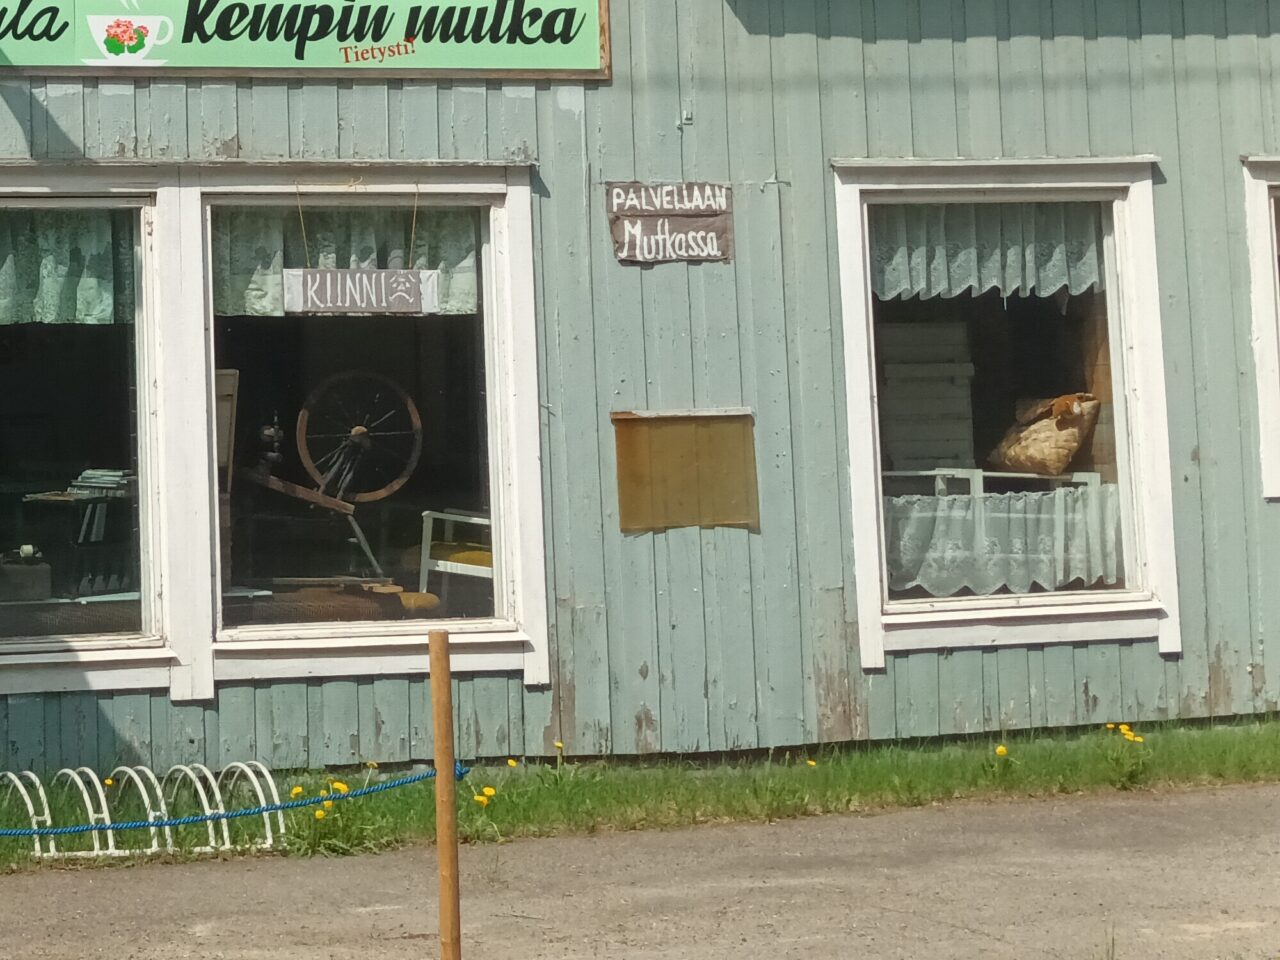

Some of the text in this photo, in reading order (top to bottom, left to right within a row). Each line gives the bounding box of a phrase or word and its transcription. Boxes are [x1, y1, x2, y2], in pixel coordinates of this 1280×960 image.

[339, 37, 415, 63] Tietysti!
[612, 183, 727, 212] PALVELLAAN
[618, 218, 722, 261] Mutkassa
[307, 272, 388, 308] KIINNI
